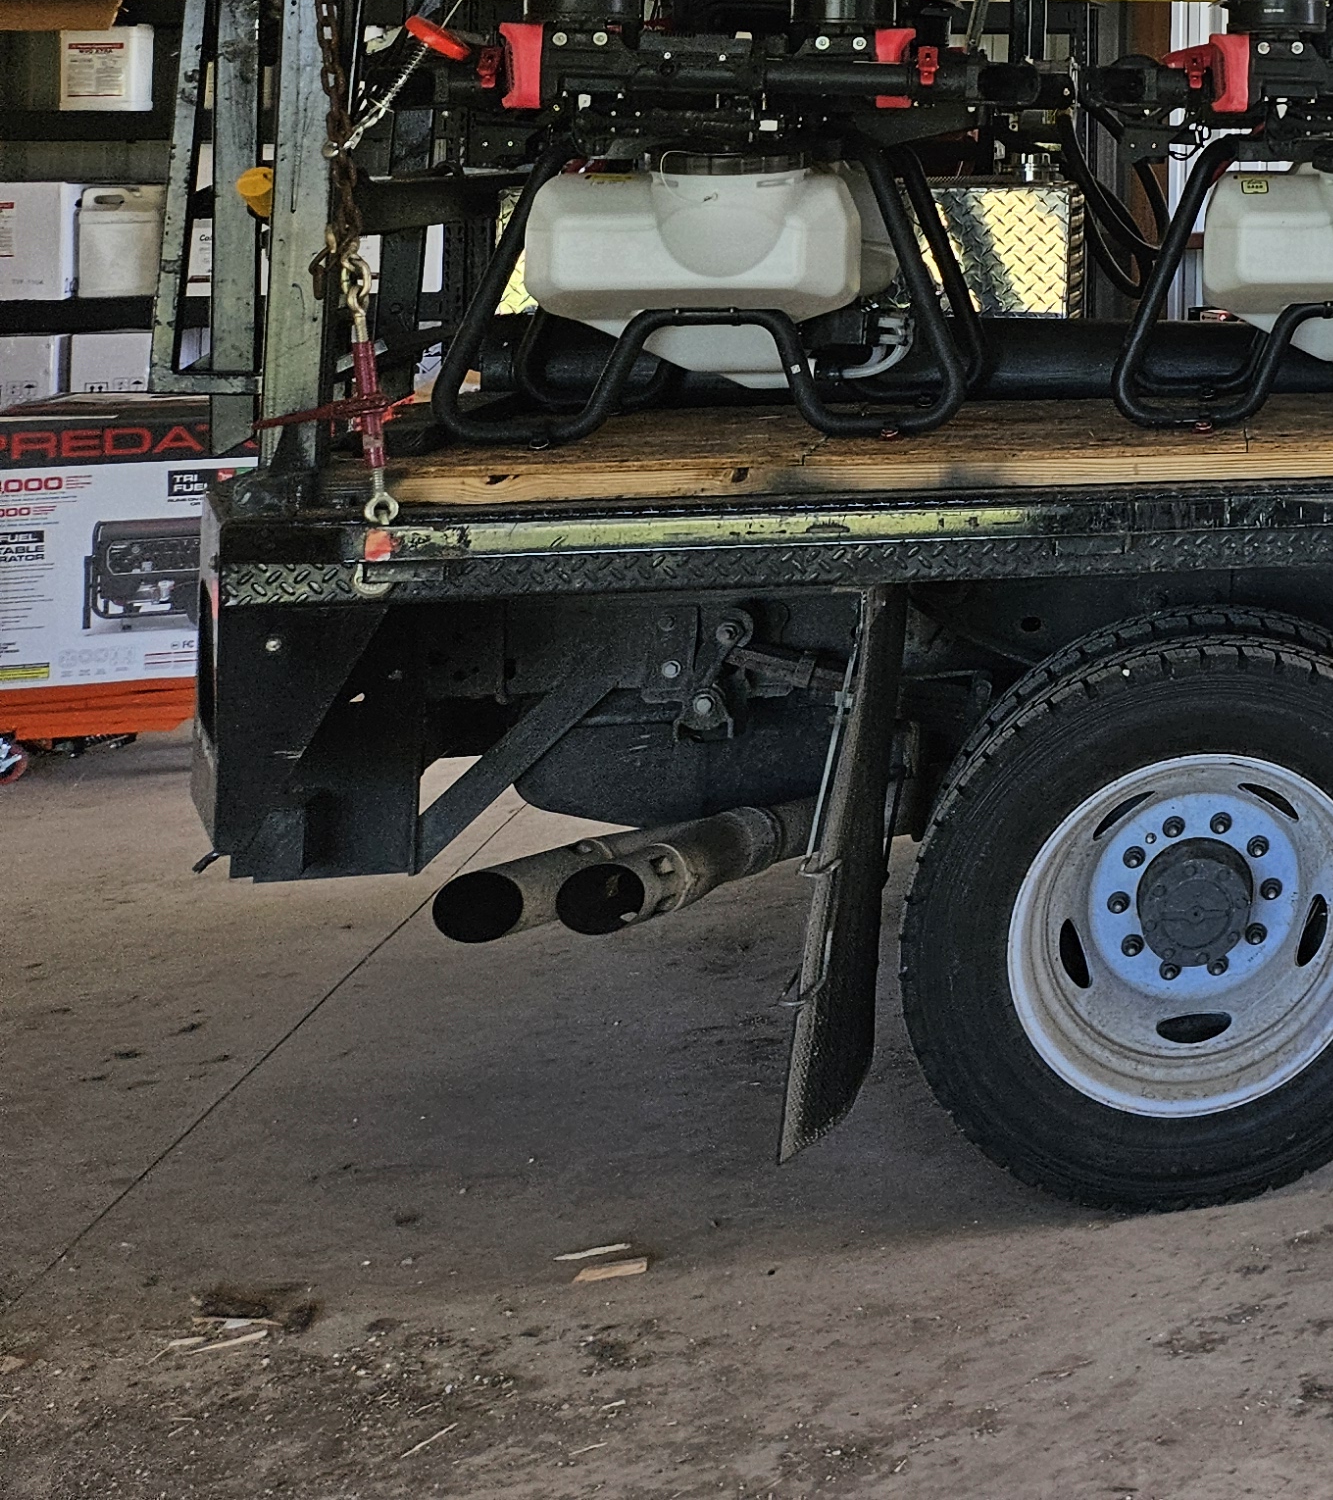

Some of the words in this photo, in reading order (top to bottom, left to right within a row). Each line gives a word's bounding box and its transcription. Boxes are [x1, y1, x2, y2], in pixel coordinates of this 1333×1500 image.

[0, 425, 210, 460] REDA
[0, 476, 63, 494] ,000
[173, 474, 199, 483] TRI
